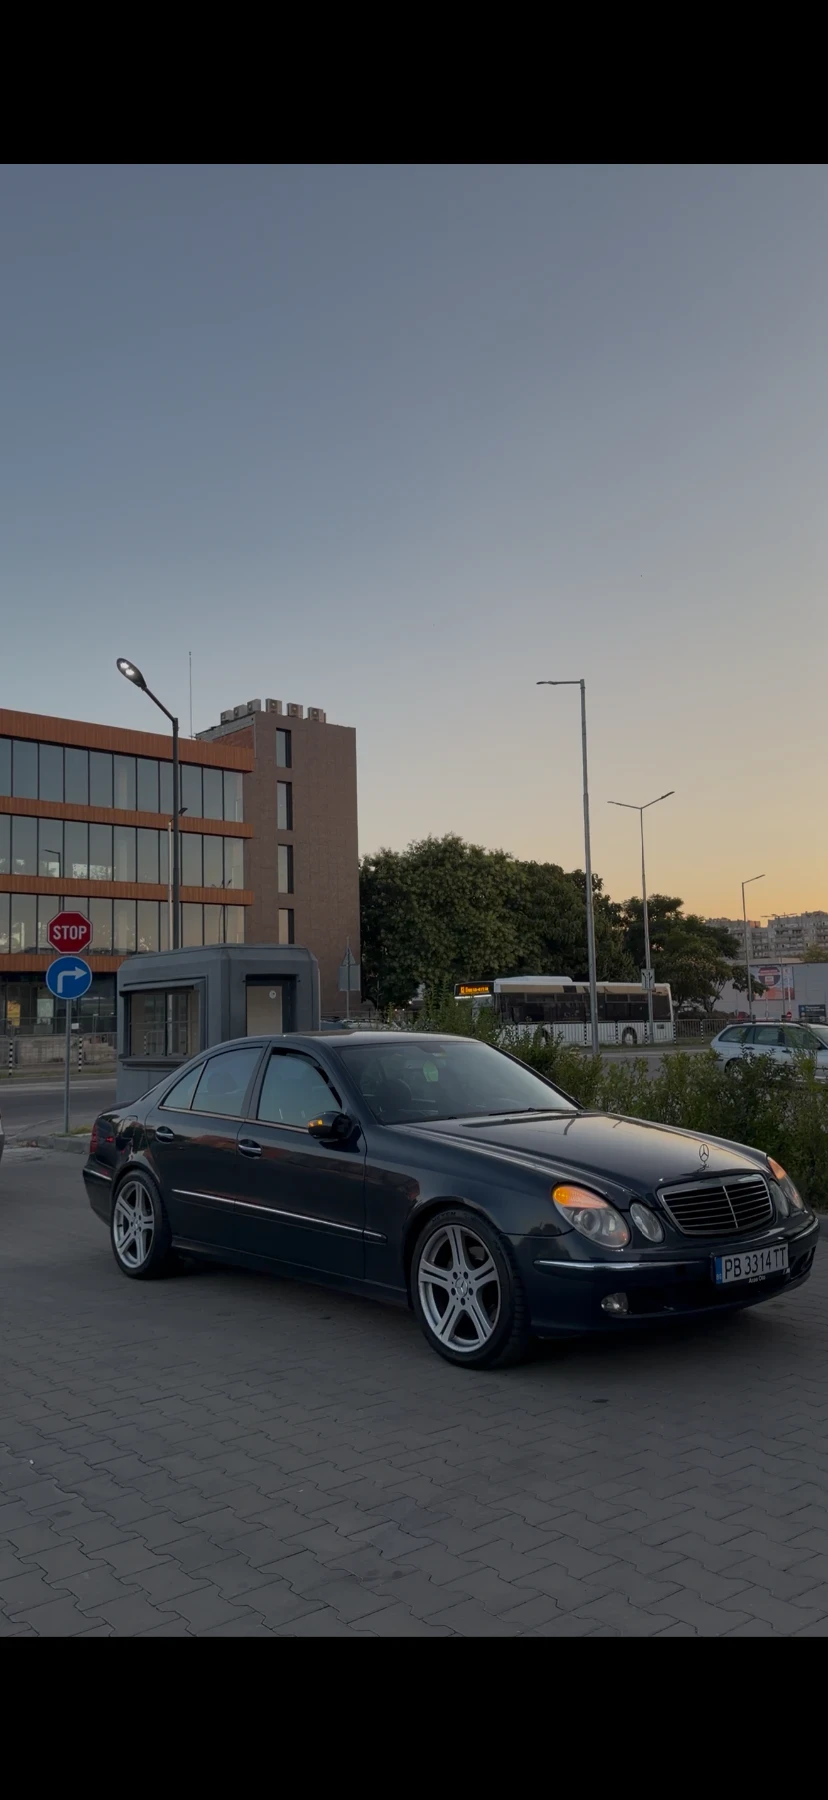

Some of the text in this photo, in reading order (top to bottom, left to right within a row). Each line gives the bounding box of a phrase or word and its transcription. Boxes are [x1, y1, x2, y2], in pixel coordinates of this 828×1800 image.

[53, 925, 87, 940] STOP
[725, 1258, 742, 1280] PB
[744, 1251, 771, 1275] 3314
